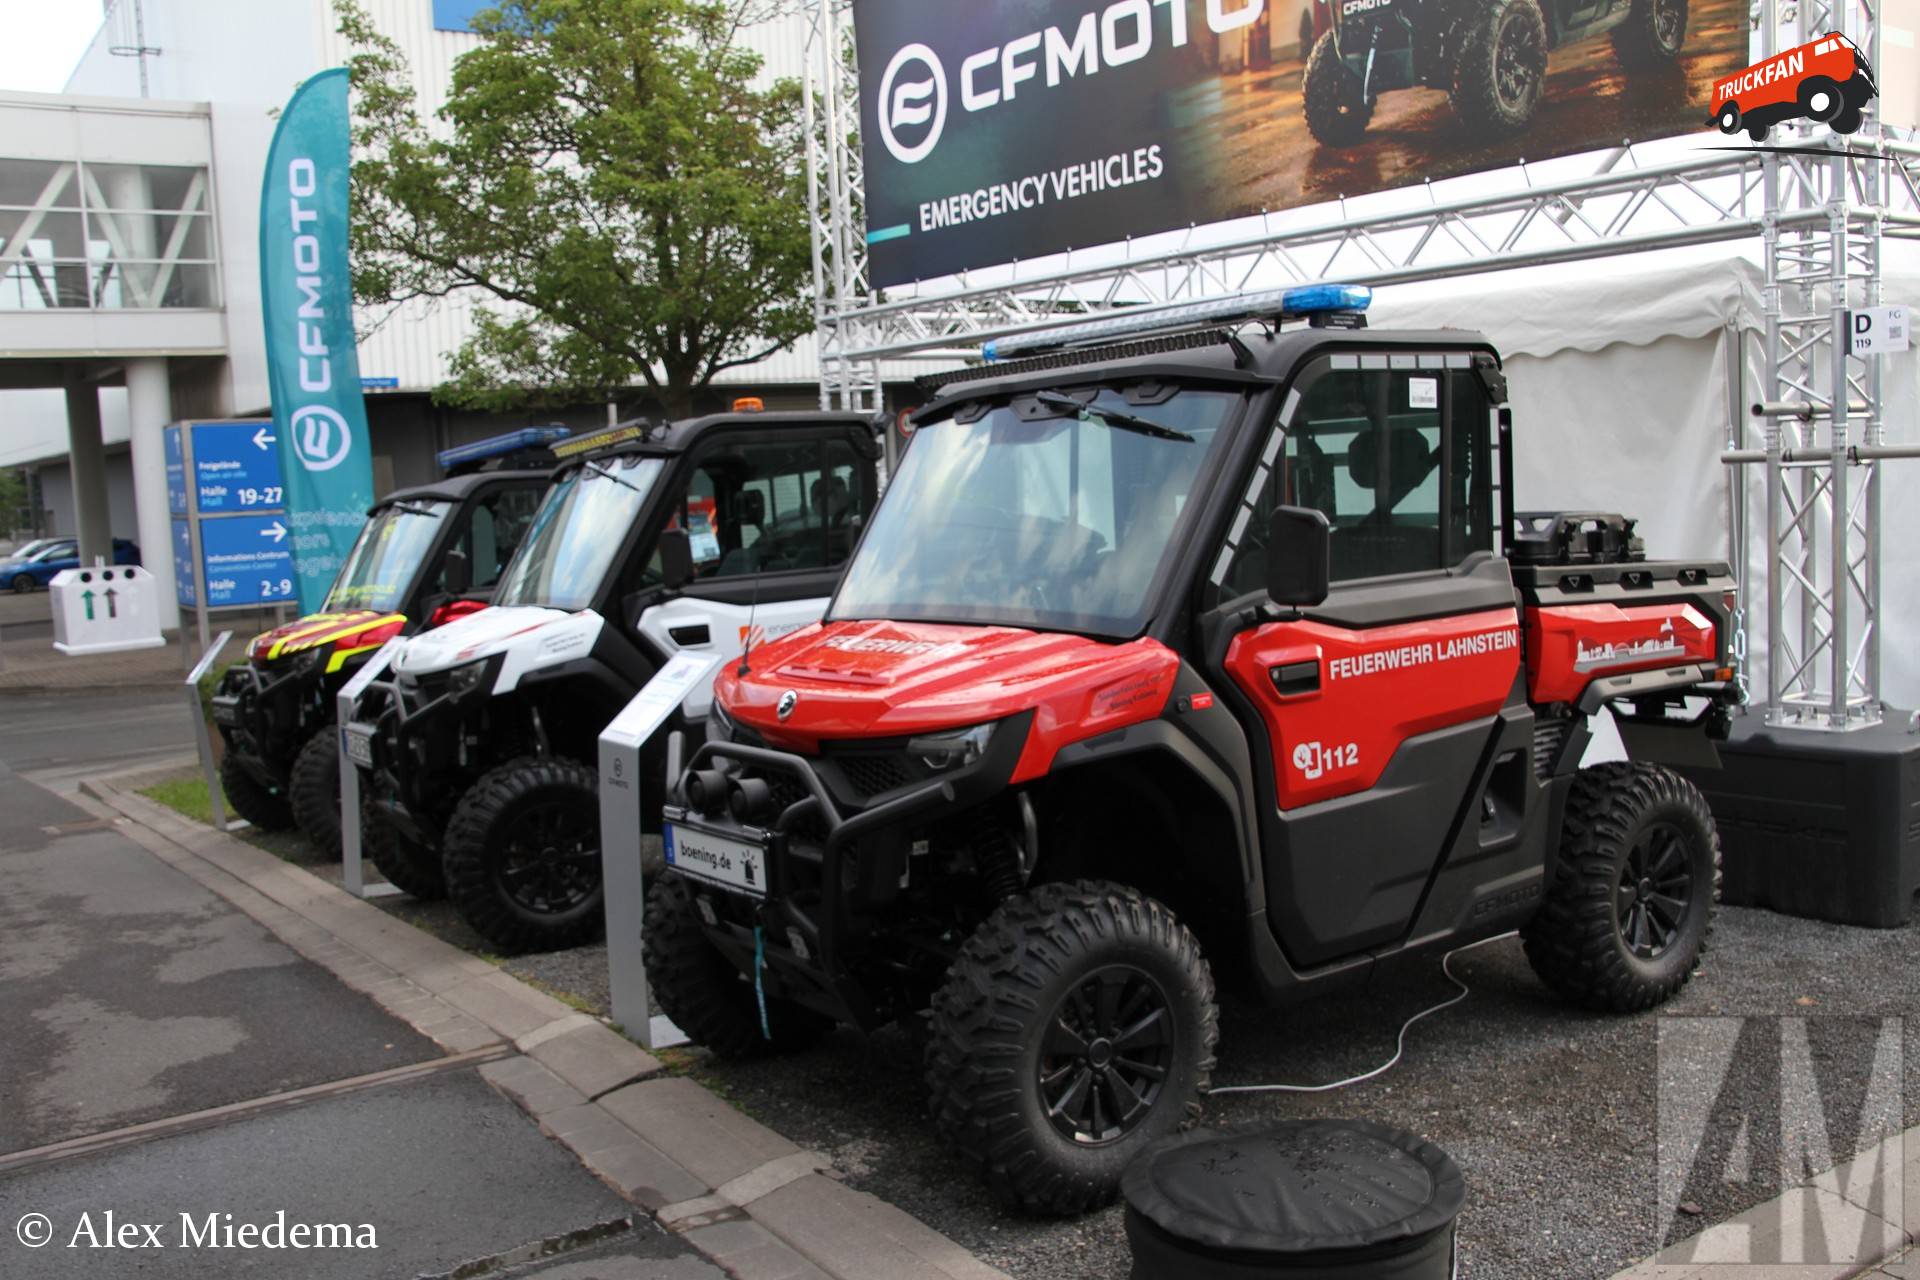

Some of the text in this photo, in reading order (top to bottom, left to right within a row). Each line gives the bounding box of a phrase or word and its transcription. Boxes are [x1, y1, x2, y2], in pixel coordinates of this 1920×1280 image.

[919, 144, 1164, 232] EMERGENCY VEHICLES
[288, 158, 332, 393] CFMOTO
[1855, 314, 1872, 334] D
[1856, 339, 1872, 348] 119
[237, 486, 283, 505] 19-27
[261, 578, 293, 597] 2-9
[1330, 629, 1517, 680] FEUERWEHR LAHNSTEIN
[1323, 743, 1359, 770] 112
[681, 840, 732, 870] boening.de
